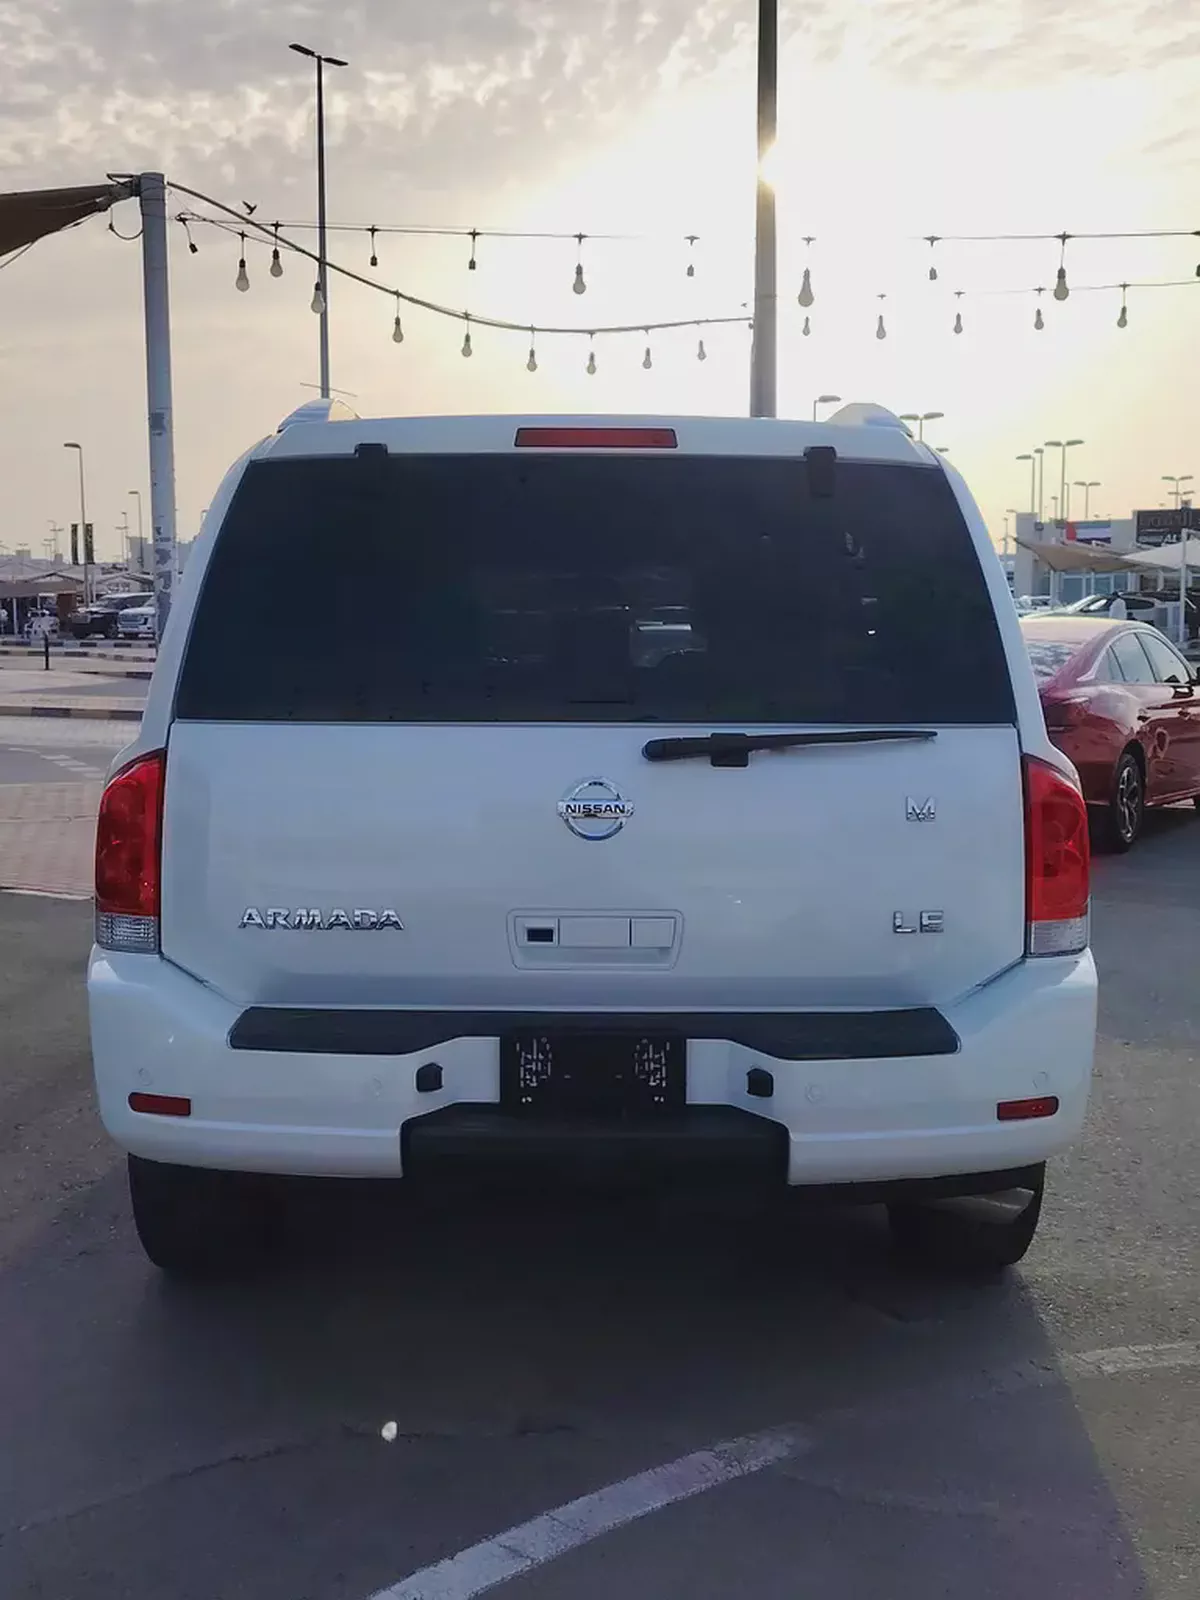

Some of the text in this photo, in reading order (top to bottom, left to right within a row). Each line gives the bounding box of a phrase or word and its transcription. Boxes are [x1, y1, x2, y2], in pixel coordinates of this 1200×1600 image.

[565, 804, 626, 814] NISSAN
[238, 907, 404, 930] ARMADA
[893, 910, 944, 934] LE
